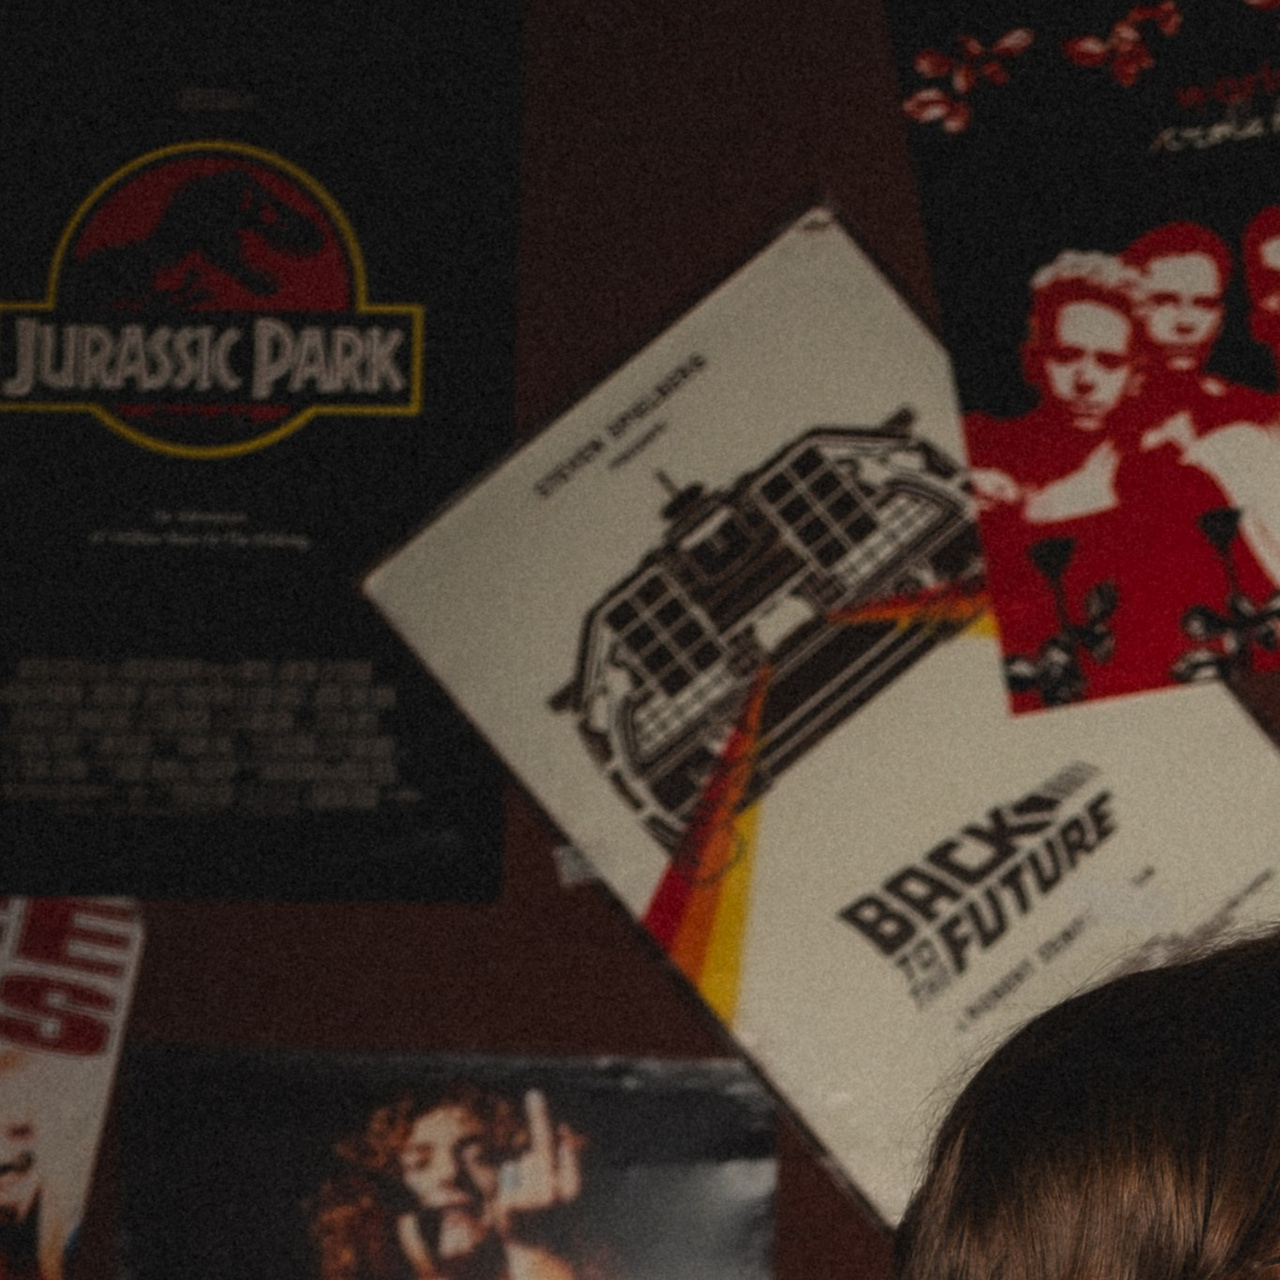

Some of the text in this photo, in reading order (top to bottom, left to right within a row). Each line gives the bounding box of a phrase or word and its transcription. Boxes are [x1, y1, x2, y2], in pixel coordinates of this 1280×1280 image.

[2, 317, 405, 400] JURASSIC PARK
[839, 792, 1062, 956] BACK
[936, 790, 1117, 975] FUTURE
